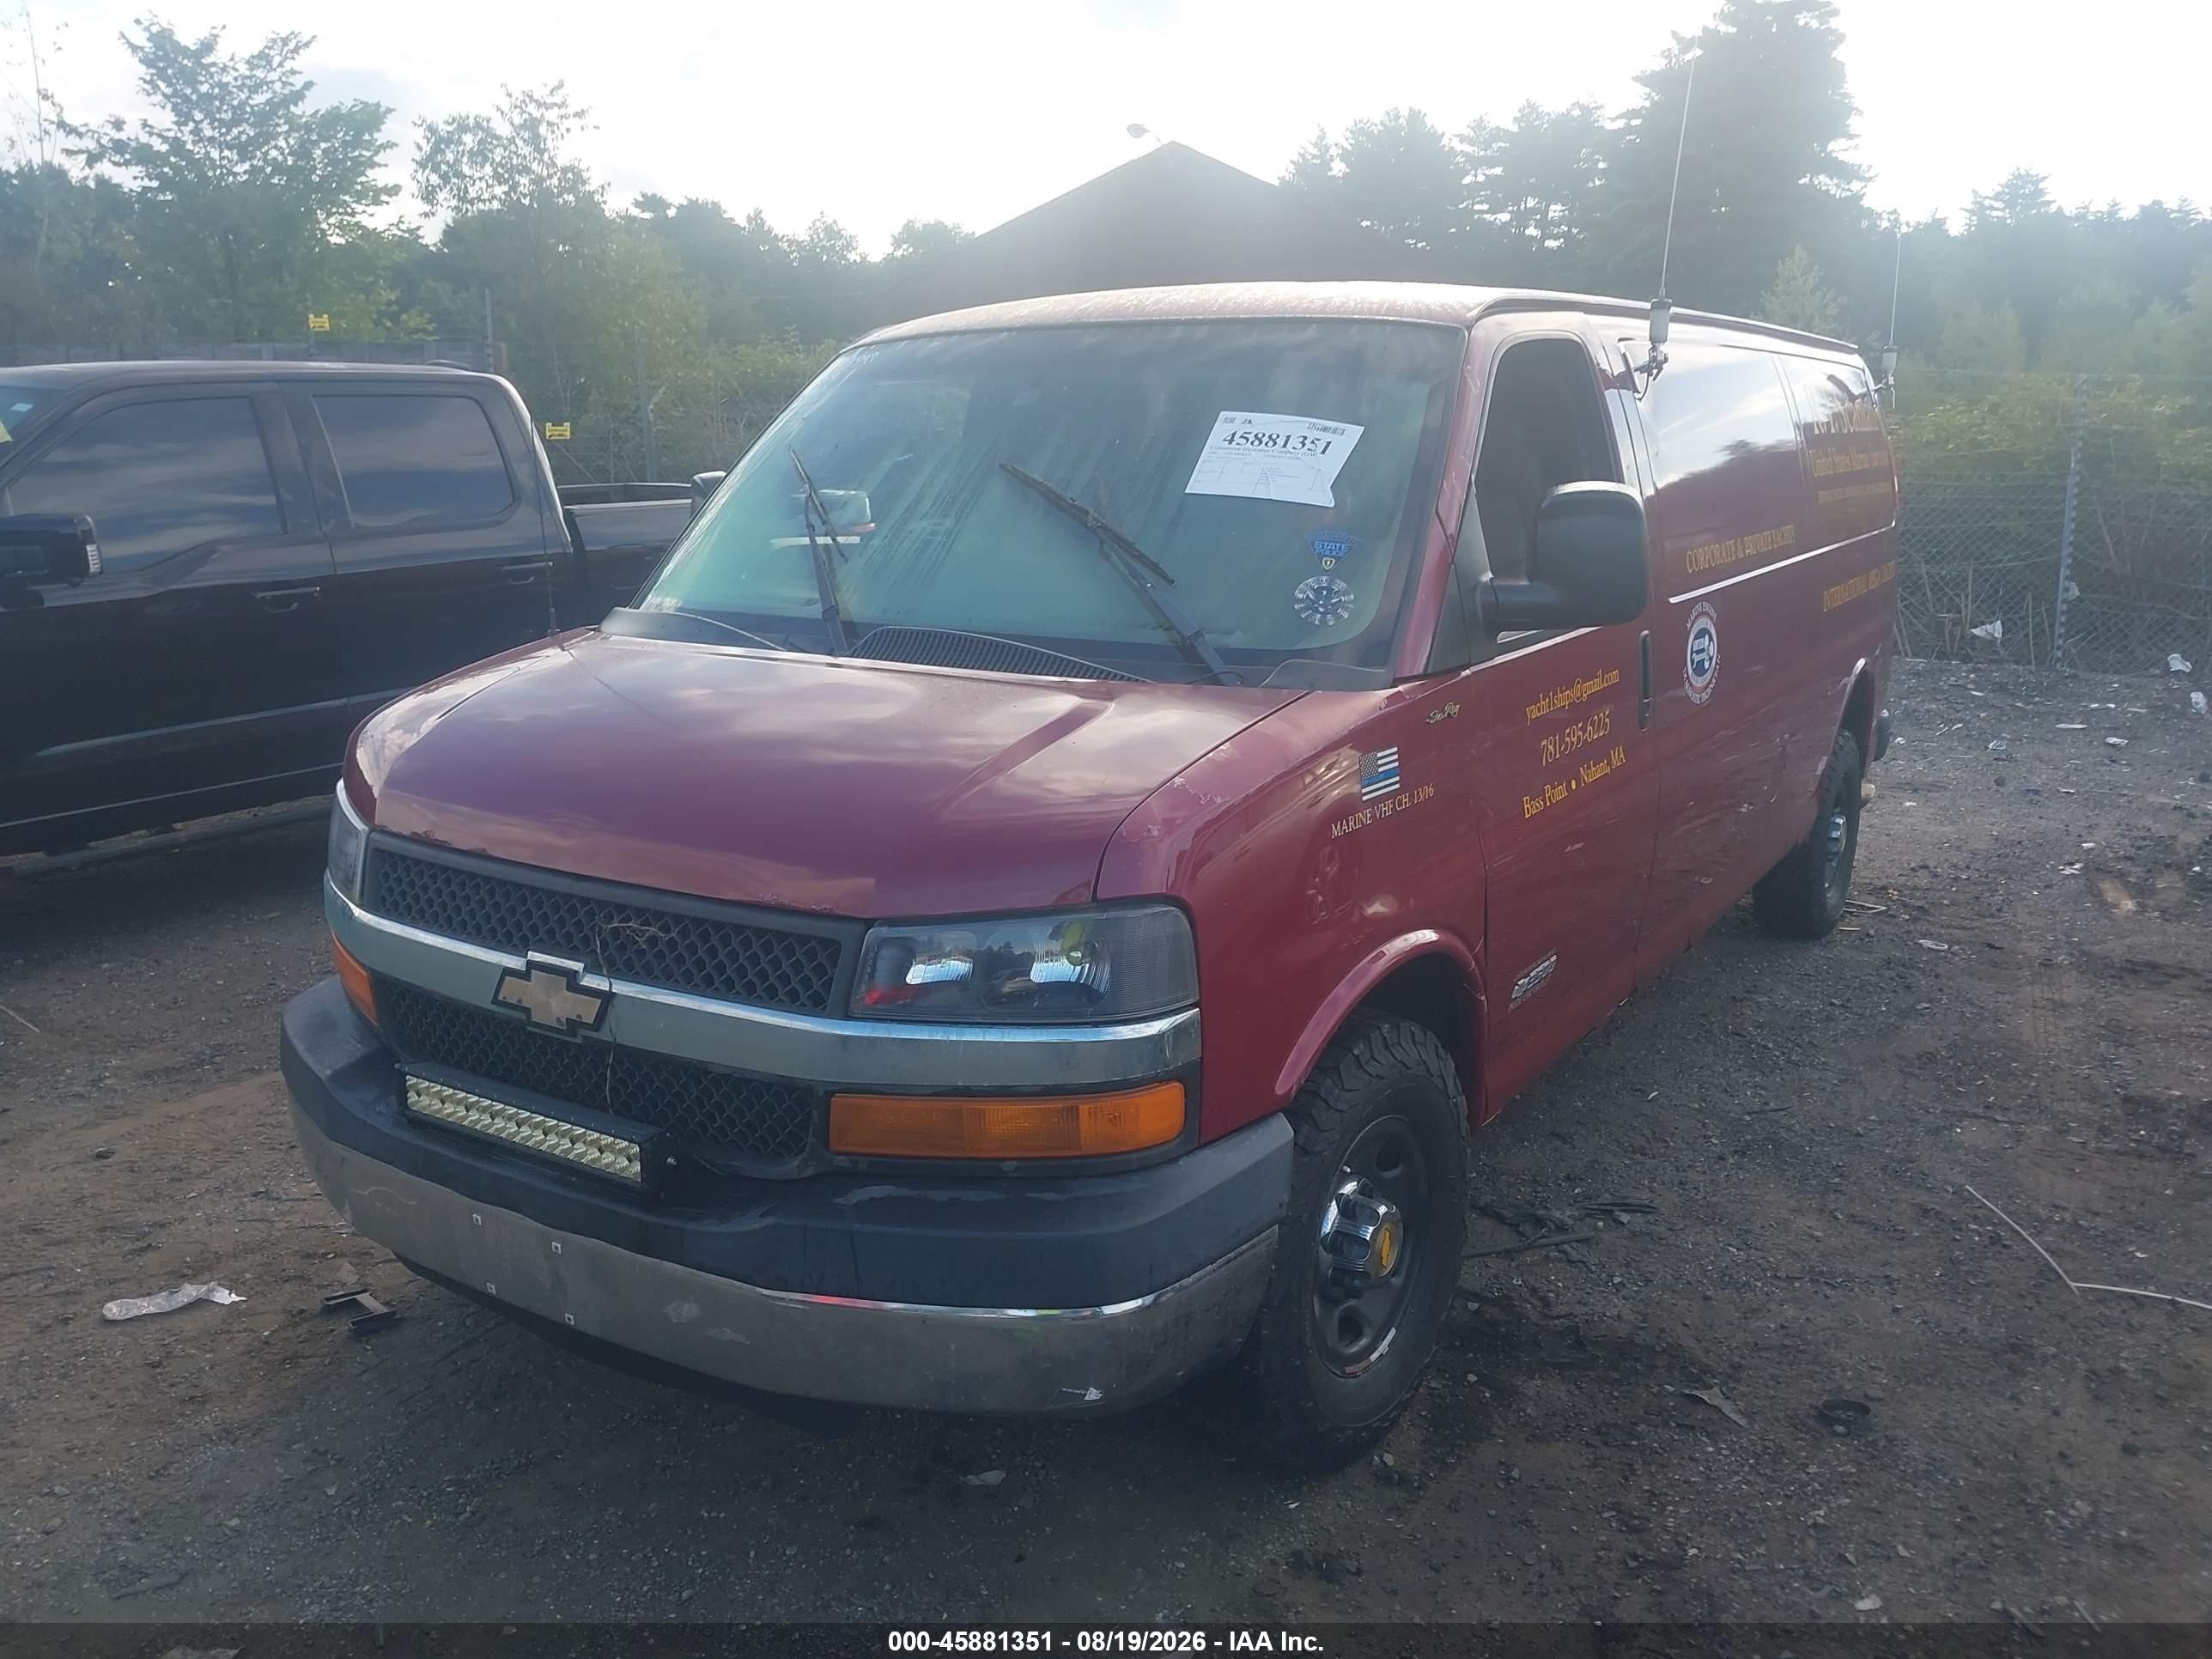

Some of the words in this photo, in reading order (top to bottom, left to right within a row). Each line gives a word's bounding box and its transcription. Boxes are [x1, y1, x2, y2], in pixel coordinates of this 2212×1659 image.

[1222, 430, 1332, 455] 45881351
[1314, 541, 1347, 550] STATE
[1686, 539, 1735, 574] CORPORATE
[1525, 668, 1620, 726] yacht1ships@gmail.com
[1540, 709, 1611, 768] 781-595-6225
[1522, 795, 1544, 819] Bass
[1544, 780, 1568, 807] Point
[1579, 757, 1611, 787] Nahant,
[1610, 744, 1627, 769] MA
[1331, 808, 1373, 839] MARINE
[1374, 799, 1395, 819] VHF
[1395, 792, 1412, 811] CH.
[1413, 782, 1435, 805] 13/16
